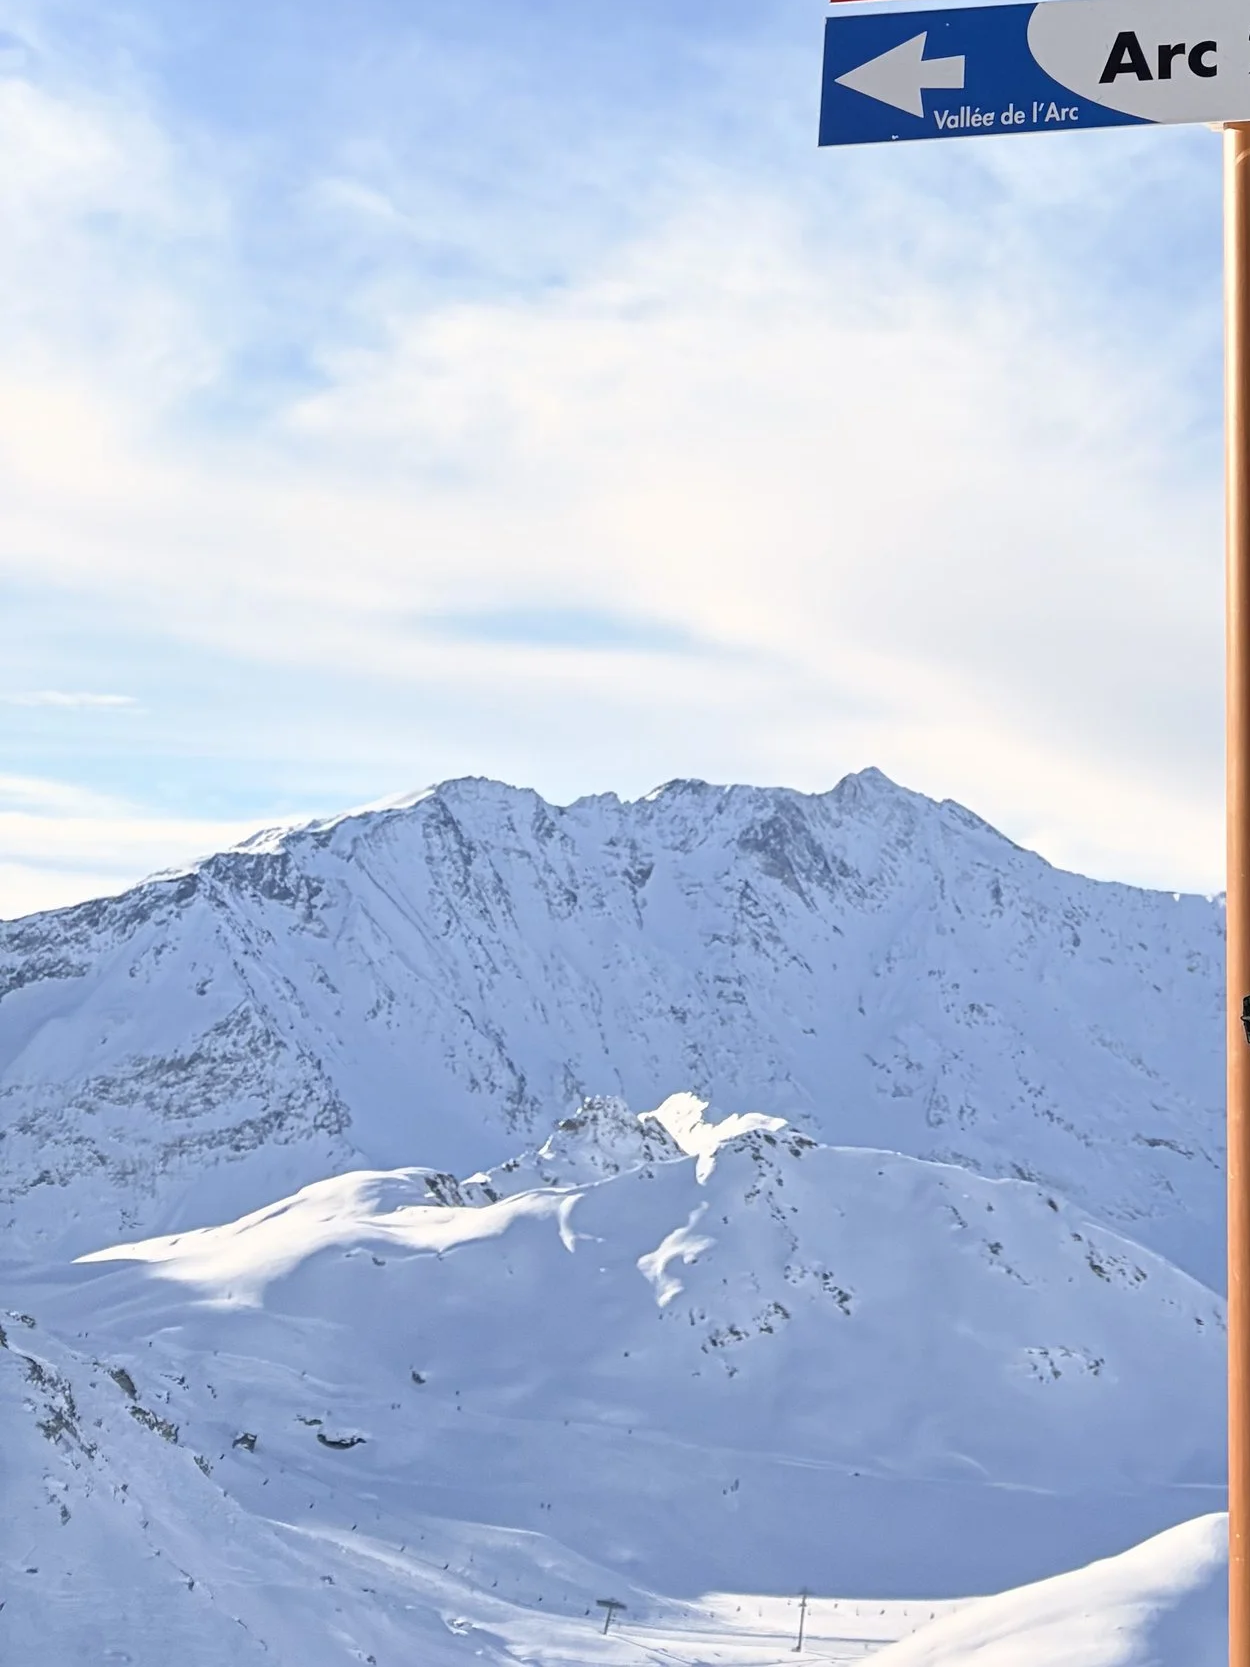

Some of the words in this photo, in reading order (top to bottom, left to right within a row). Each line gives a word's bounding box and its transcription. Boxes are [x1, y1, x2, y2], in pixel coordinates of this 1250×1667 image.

[1098, 31, 1218, 84] Arc
[933, 107, 995, 130] Vallée
[1000, 103, 1026, 125] de
[1032, 101, 1079, 123] l'Arc
